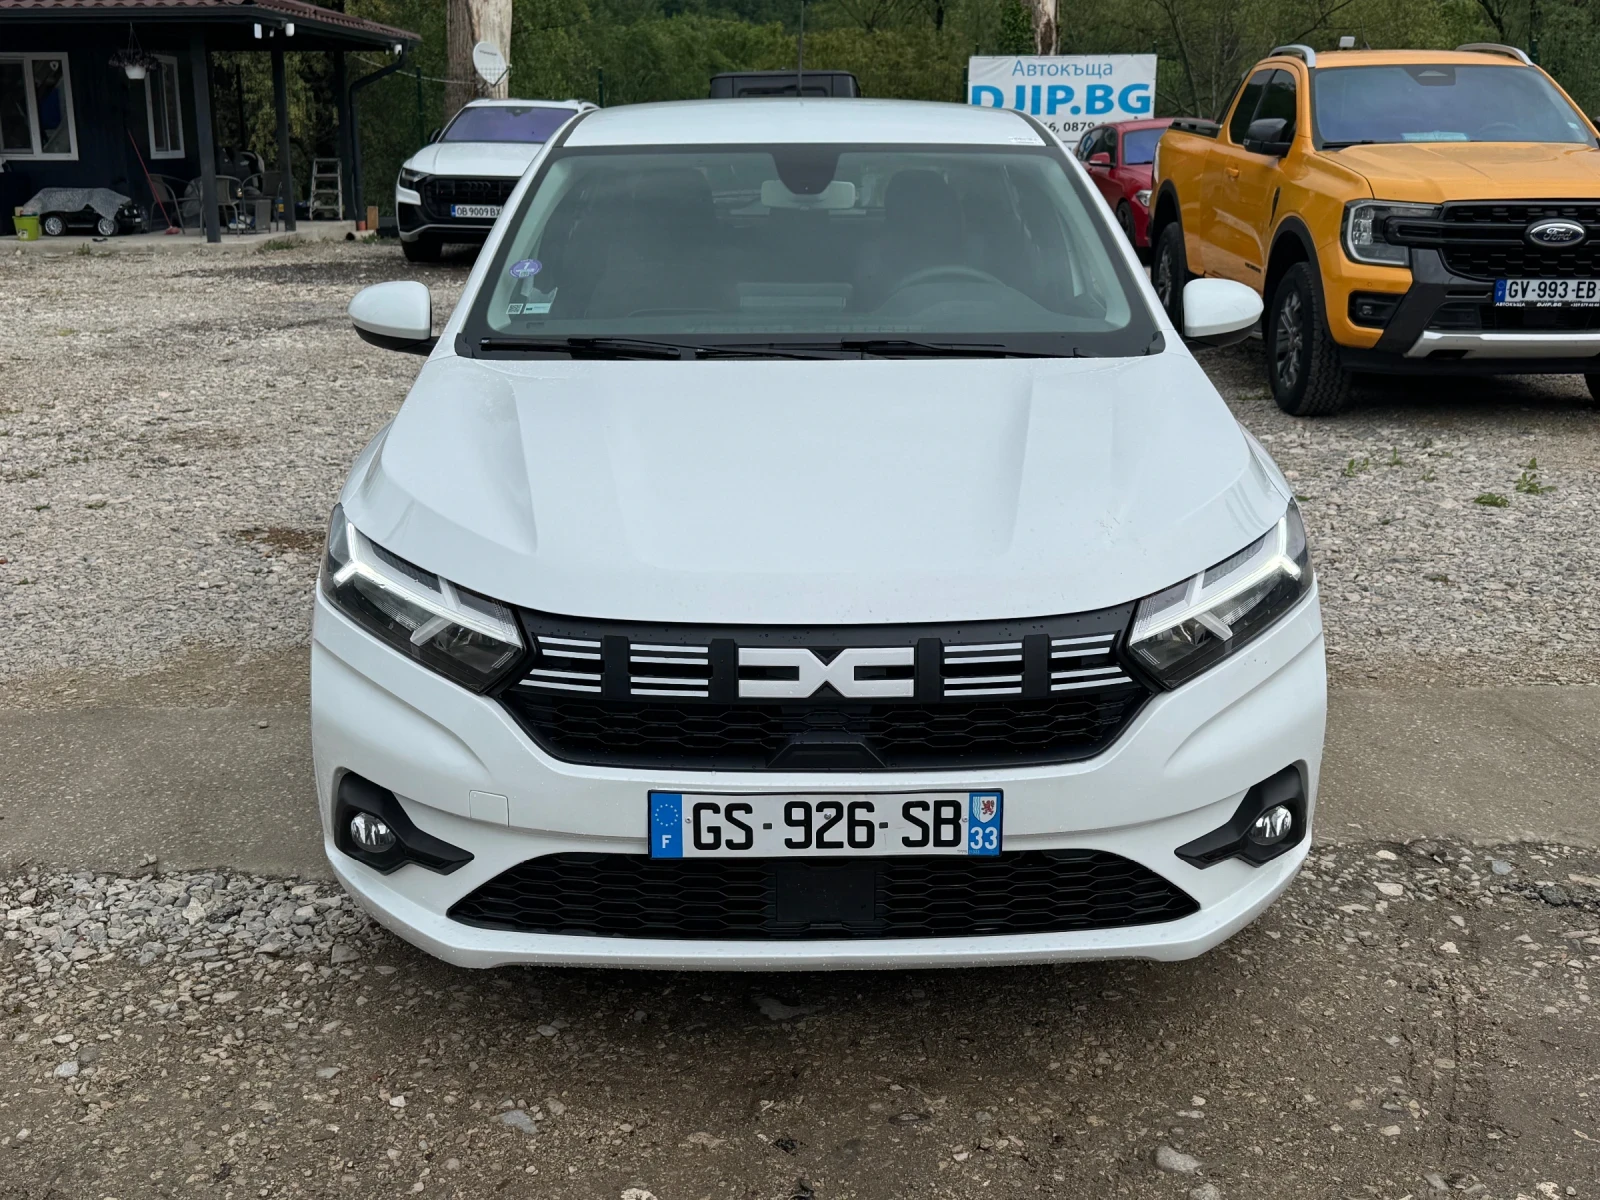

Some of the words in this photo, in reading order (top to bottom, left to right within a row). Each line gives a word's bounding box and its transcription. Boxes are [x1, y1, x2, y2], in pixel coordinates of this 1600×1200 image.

[1012, 60, 1113, 78] Автокъща
[972, 83, 1152, 116] DJIP.BG
[469, 206, 489, 217] 9009
[1543, 227, 1573, 240] Ford
[661, 834, 672, 849] F
[692, 799, 963, 850] GS-926-SB
[970, 826, 998, 850] 33
